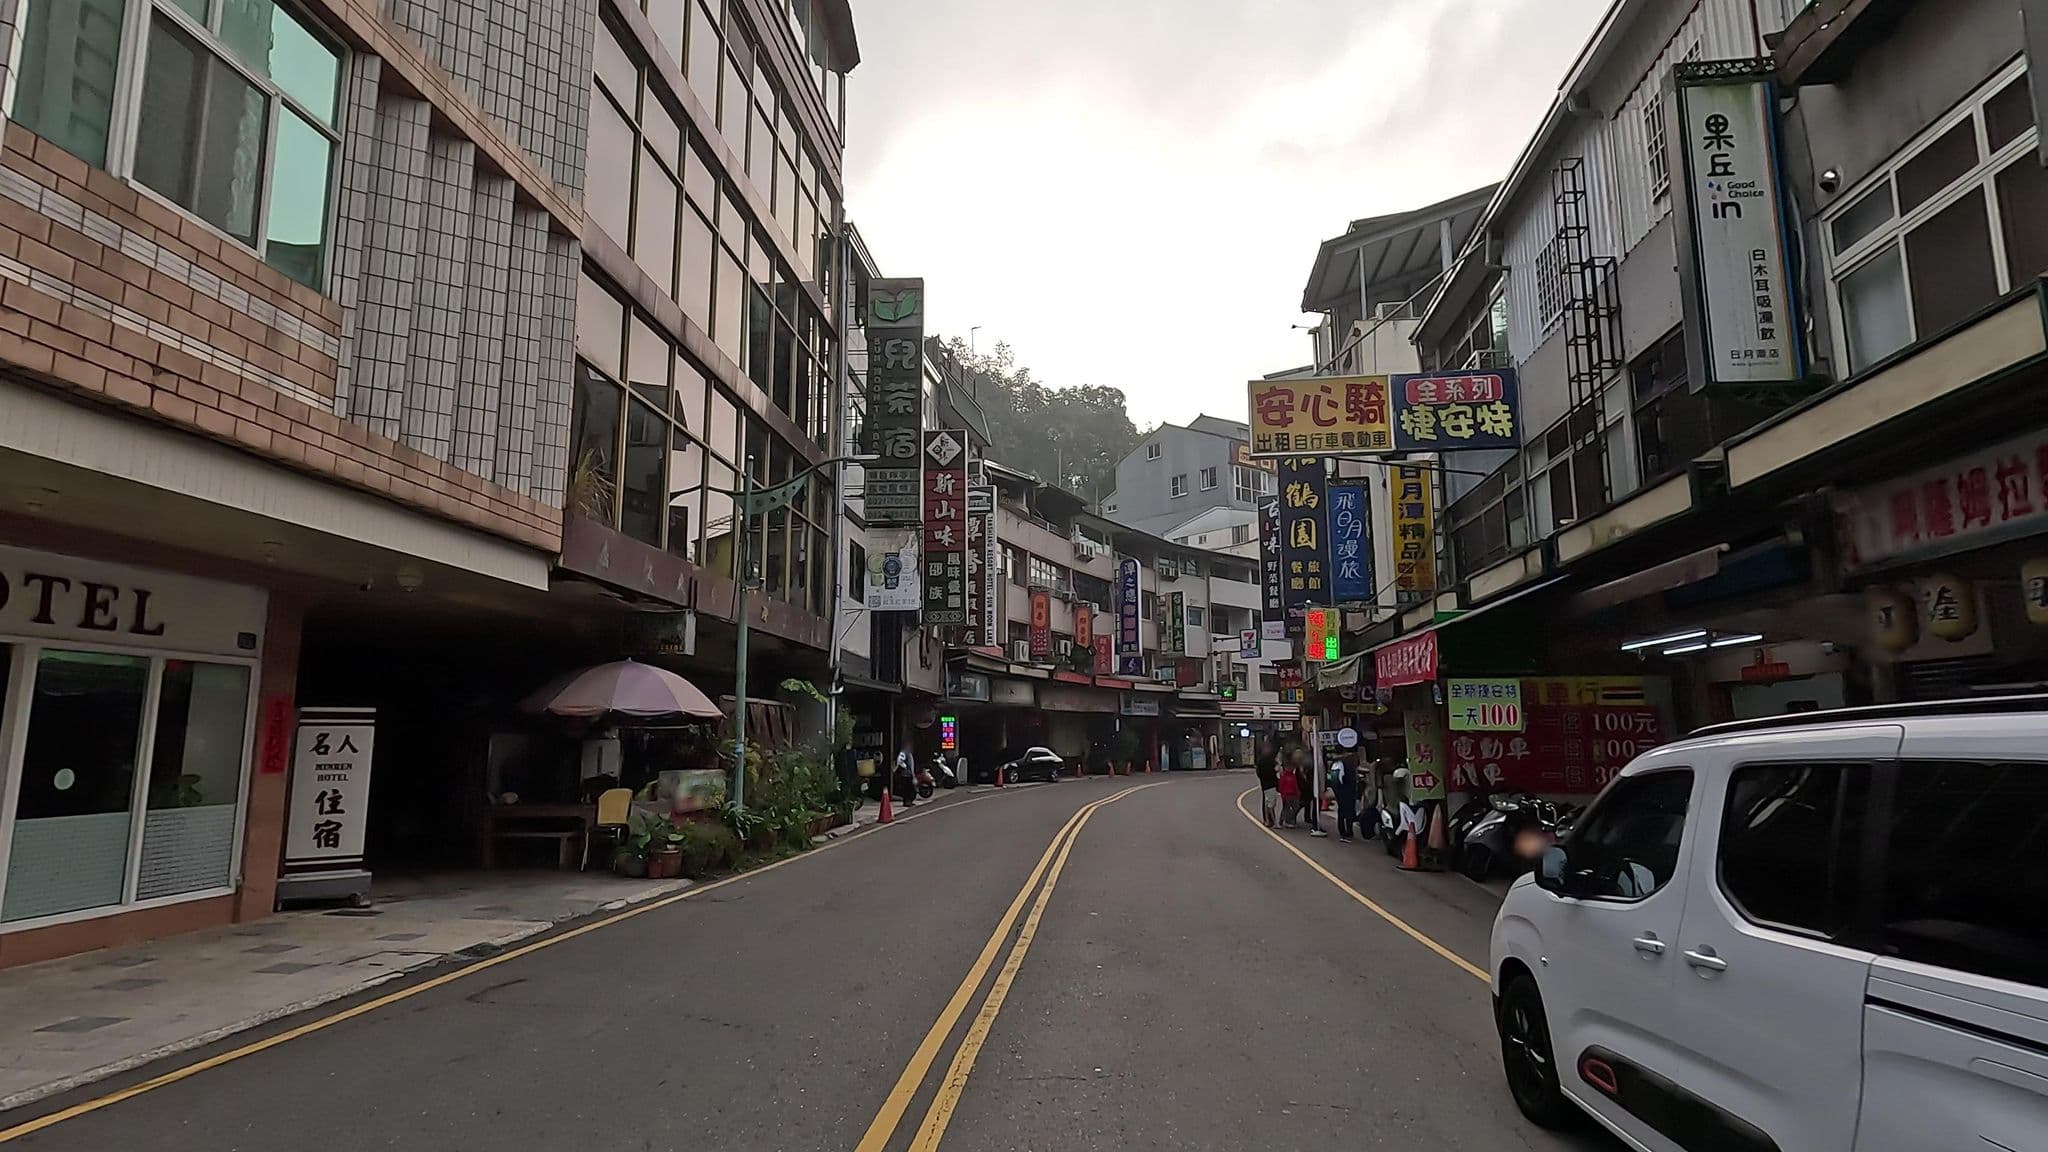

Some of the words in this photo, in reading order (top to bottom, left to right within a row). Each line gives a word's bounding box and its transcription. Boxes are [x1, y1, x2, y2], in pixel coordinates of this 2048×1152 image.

[1702, 113, 1736, 178] 果丘
[1727, 180, 1755, 189] Good
[1728, 188, 1764, 198] Choice
[1416, 377, 1494, 401] 全系列
[1256, 381, 1386, 428] 安心騎
[1400, 401, 1514, 441] 捷安特
[1256, 431, 1387, 452] 出租自行車電動車
[932, 472, 956, 547] 新山味
[309, 733, 358, 756] 名人
[1452, 736, 1531, 761] 電動車
[317, 774, 349, 782] HOTEL
[312, 789, 345, 849] 住宿
